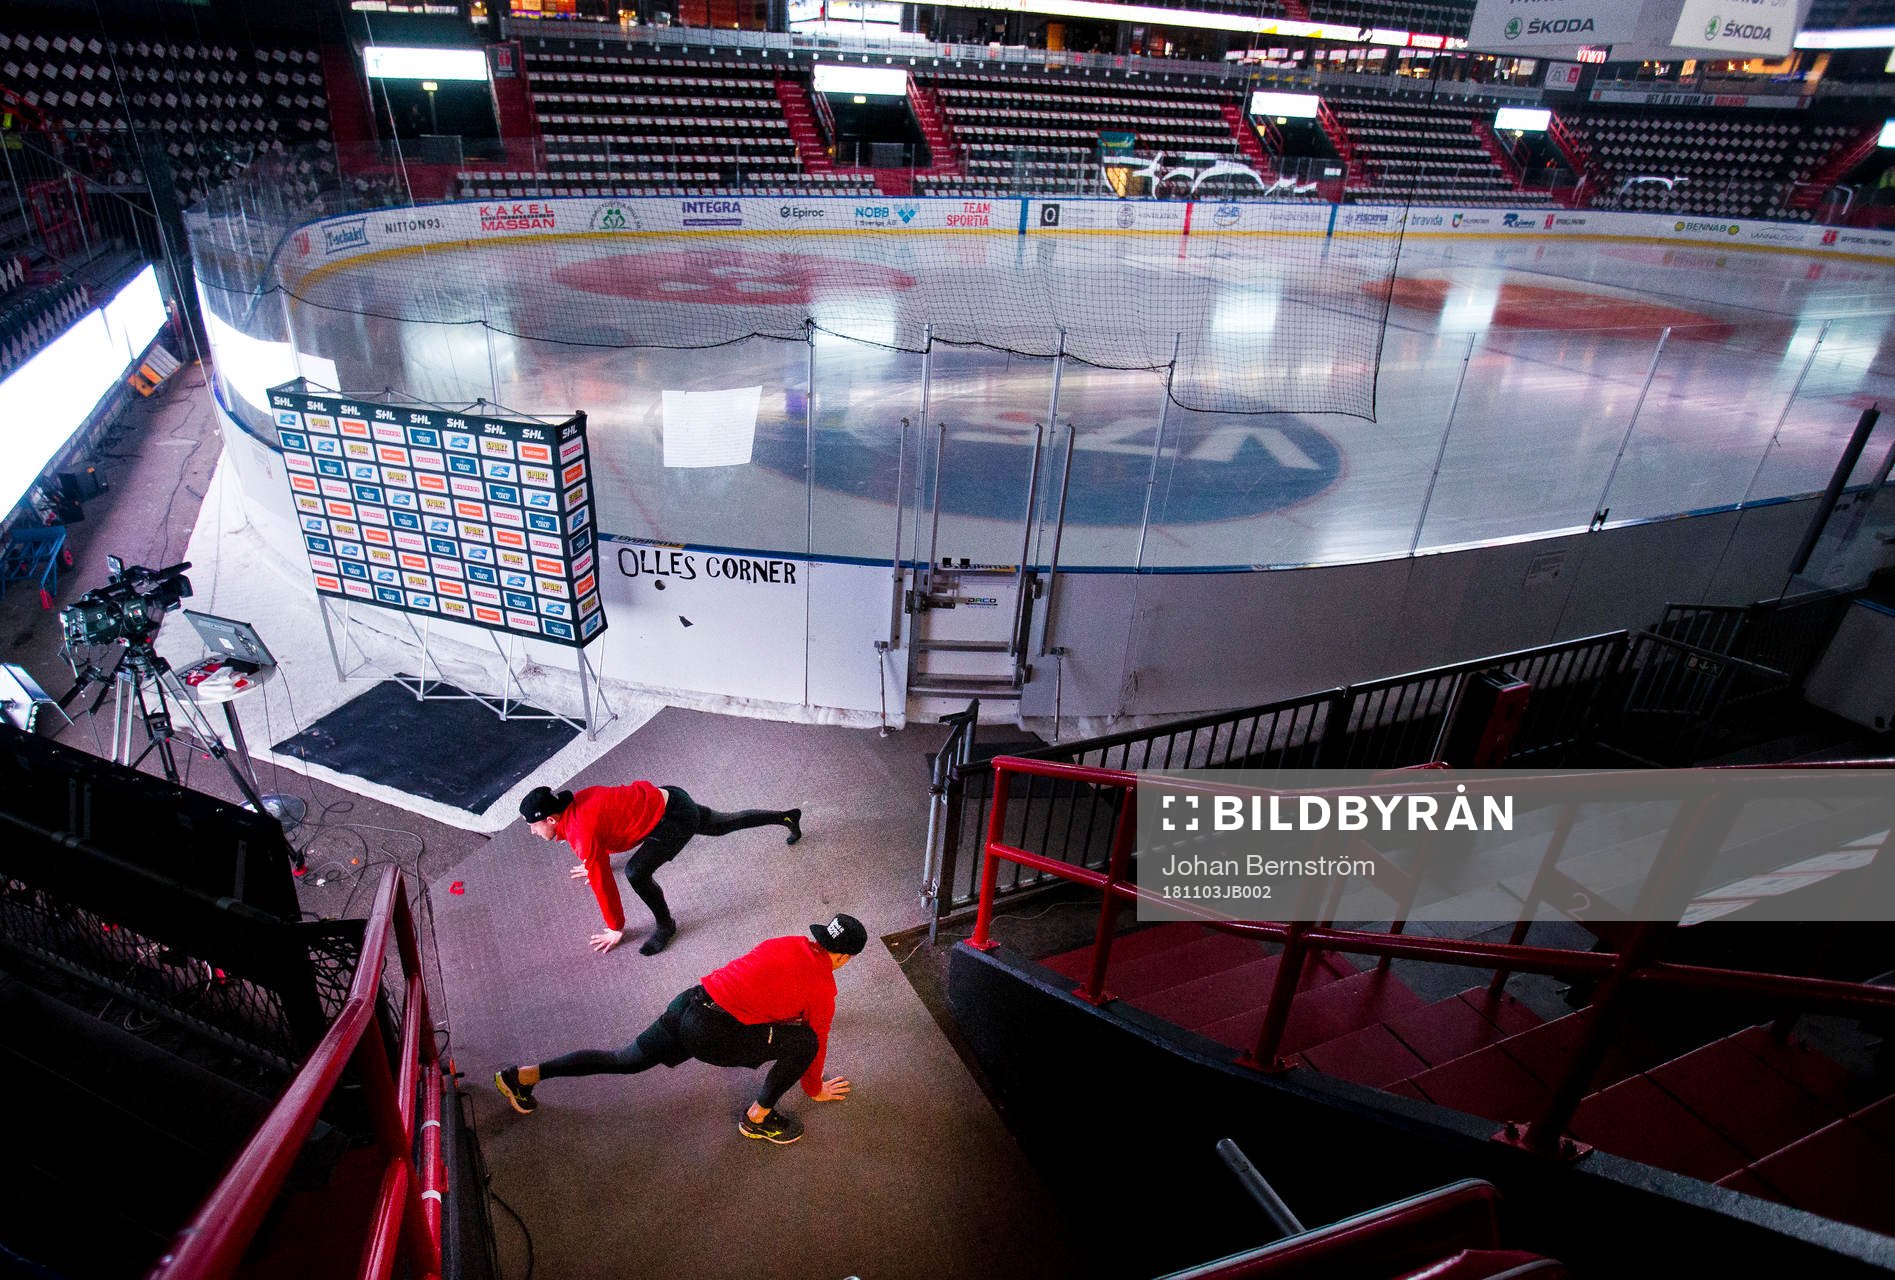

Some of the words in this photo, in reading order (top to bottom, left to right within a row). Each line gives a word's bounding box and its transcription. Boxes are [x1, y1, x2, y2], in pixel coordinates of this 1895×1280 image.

[1527, 18, 1594, 34] ŠKODA
[1722, 20, 1772, 41] ŠKODA
[480, 204, 554, 216] KAKEL
[682, 202, 742, 214] INTEGRA
[793, 207, 825, 218] Epiroc
[856, 207, 889, 218] NOBB
[963, 202, 991, 214] TEAM
[946, 214, 989, 227] SPORTIA
[1411, 214, 1443, 226] bravida
[1686, 222, 1727, 233] BENNAB
[274, 396, 293, 407] SHL
[307, 400, 327, 411] SHL
[340, 404, 360, 416] SHL
[375, 409, 396, 421] SHL
[410, 413, 431, 425] SHL
[446, 418, 468, 430] SHL
[484, 423, 507, 435] SHL
[522, 428, 545, 440] SHL
[562, 424, 578, 439] SHL
[617, 547, 697, 580] OLLES
[706, 556, 797, 585] CORNER
